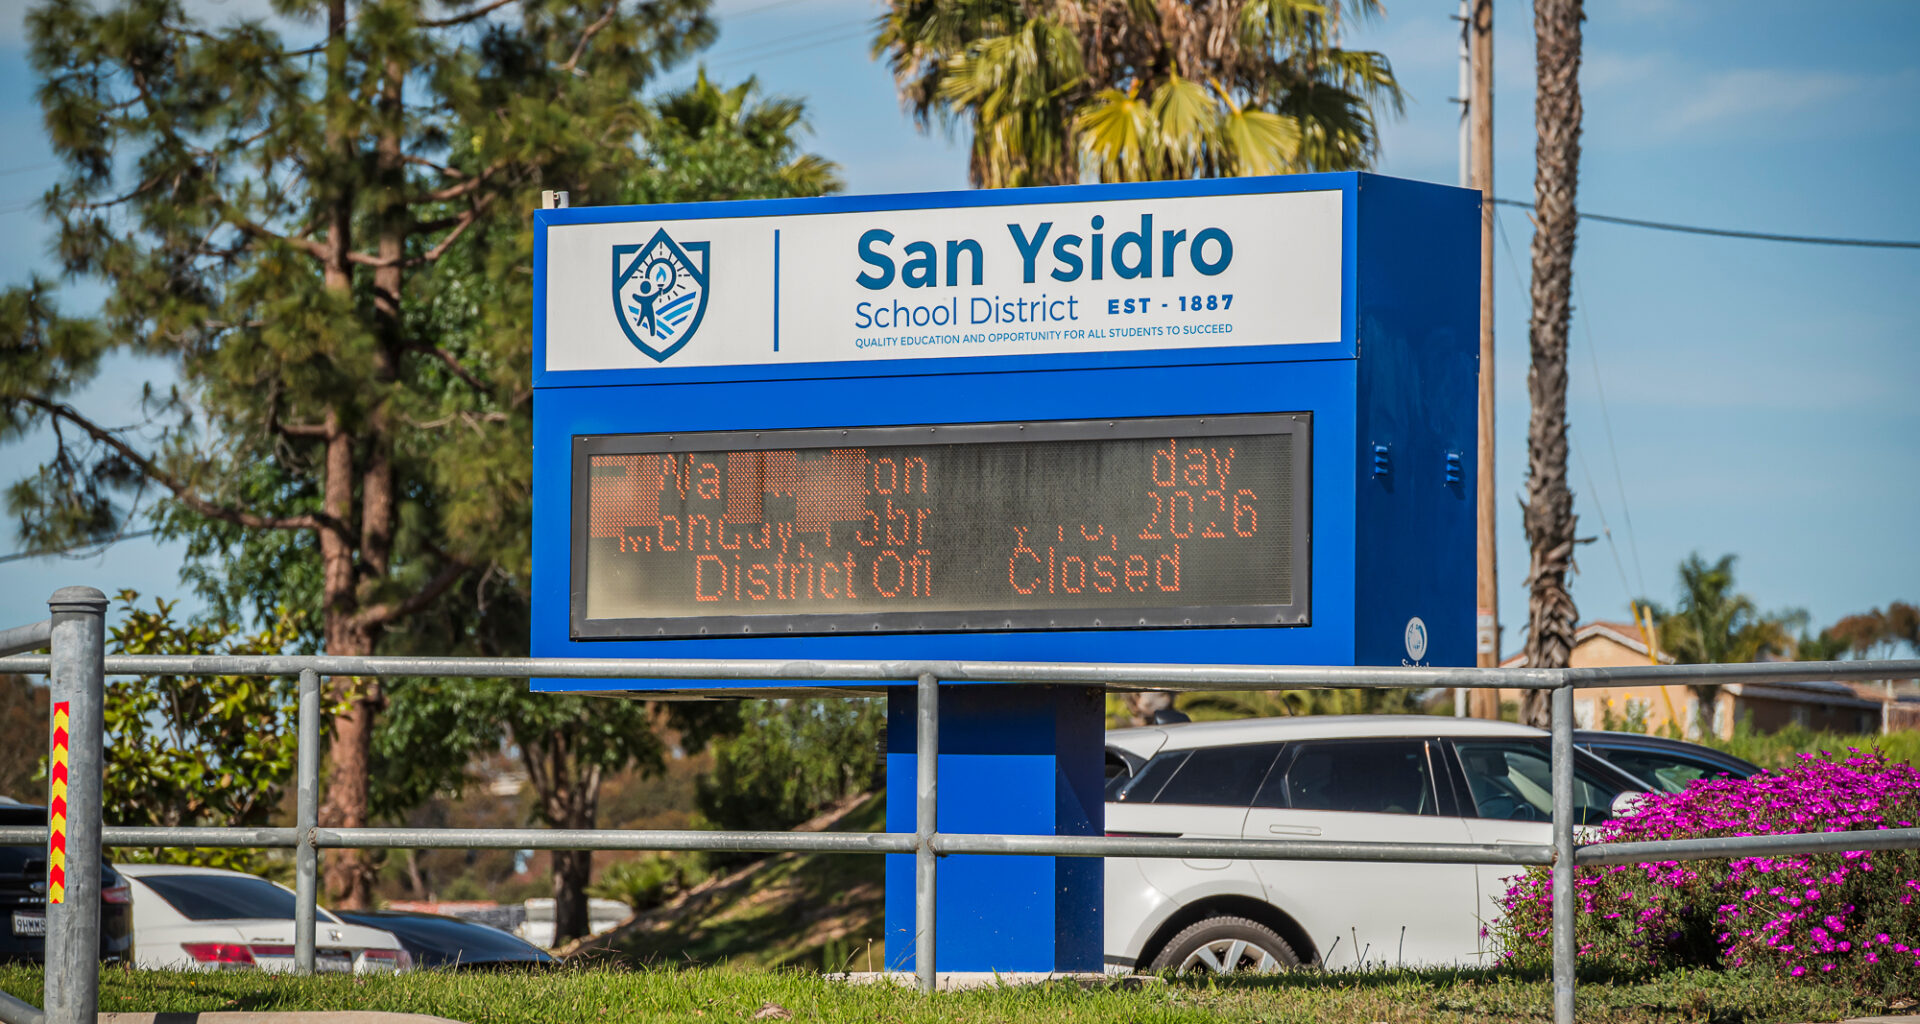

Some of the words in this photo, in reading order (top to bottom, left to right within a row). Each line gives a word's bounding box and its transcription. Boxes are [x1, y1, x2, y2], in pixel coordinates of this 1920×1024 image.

[855, 229, 983, 291] San
[1006, 213, 1234, 284] Ysidro
[854, 296, 957, 329] School
[970, 294, 1079, 325] District
[1107, 297, 1151, 315] EST
[1178, 294, 1234, 312] 1887
[855, 337, 898, 349] QUALITY
[900, 334, 960, 346] EDUCATION
[962, 333, 986, 344] AND
[988, 330, 1062, 343] OPPORTUNITY
[1063, 329, 1085, 340] FOR
[1087, 329, 1107, 339] ALL
[1108, 326, 1164, 338] STUDENTS
[1165, 325, 1181, 336] TO
[1182, 323, 1233, 335] SUCCEED
[1139, 489, 1257, 539] 2026
[696, 551, 857, 602] District
[1008, 543, 1180, 595] Closed
